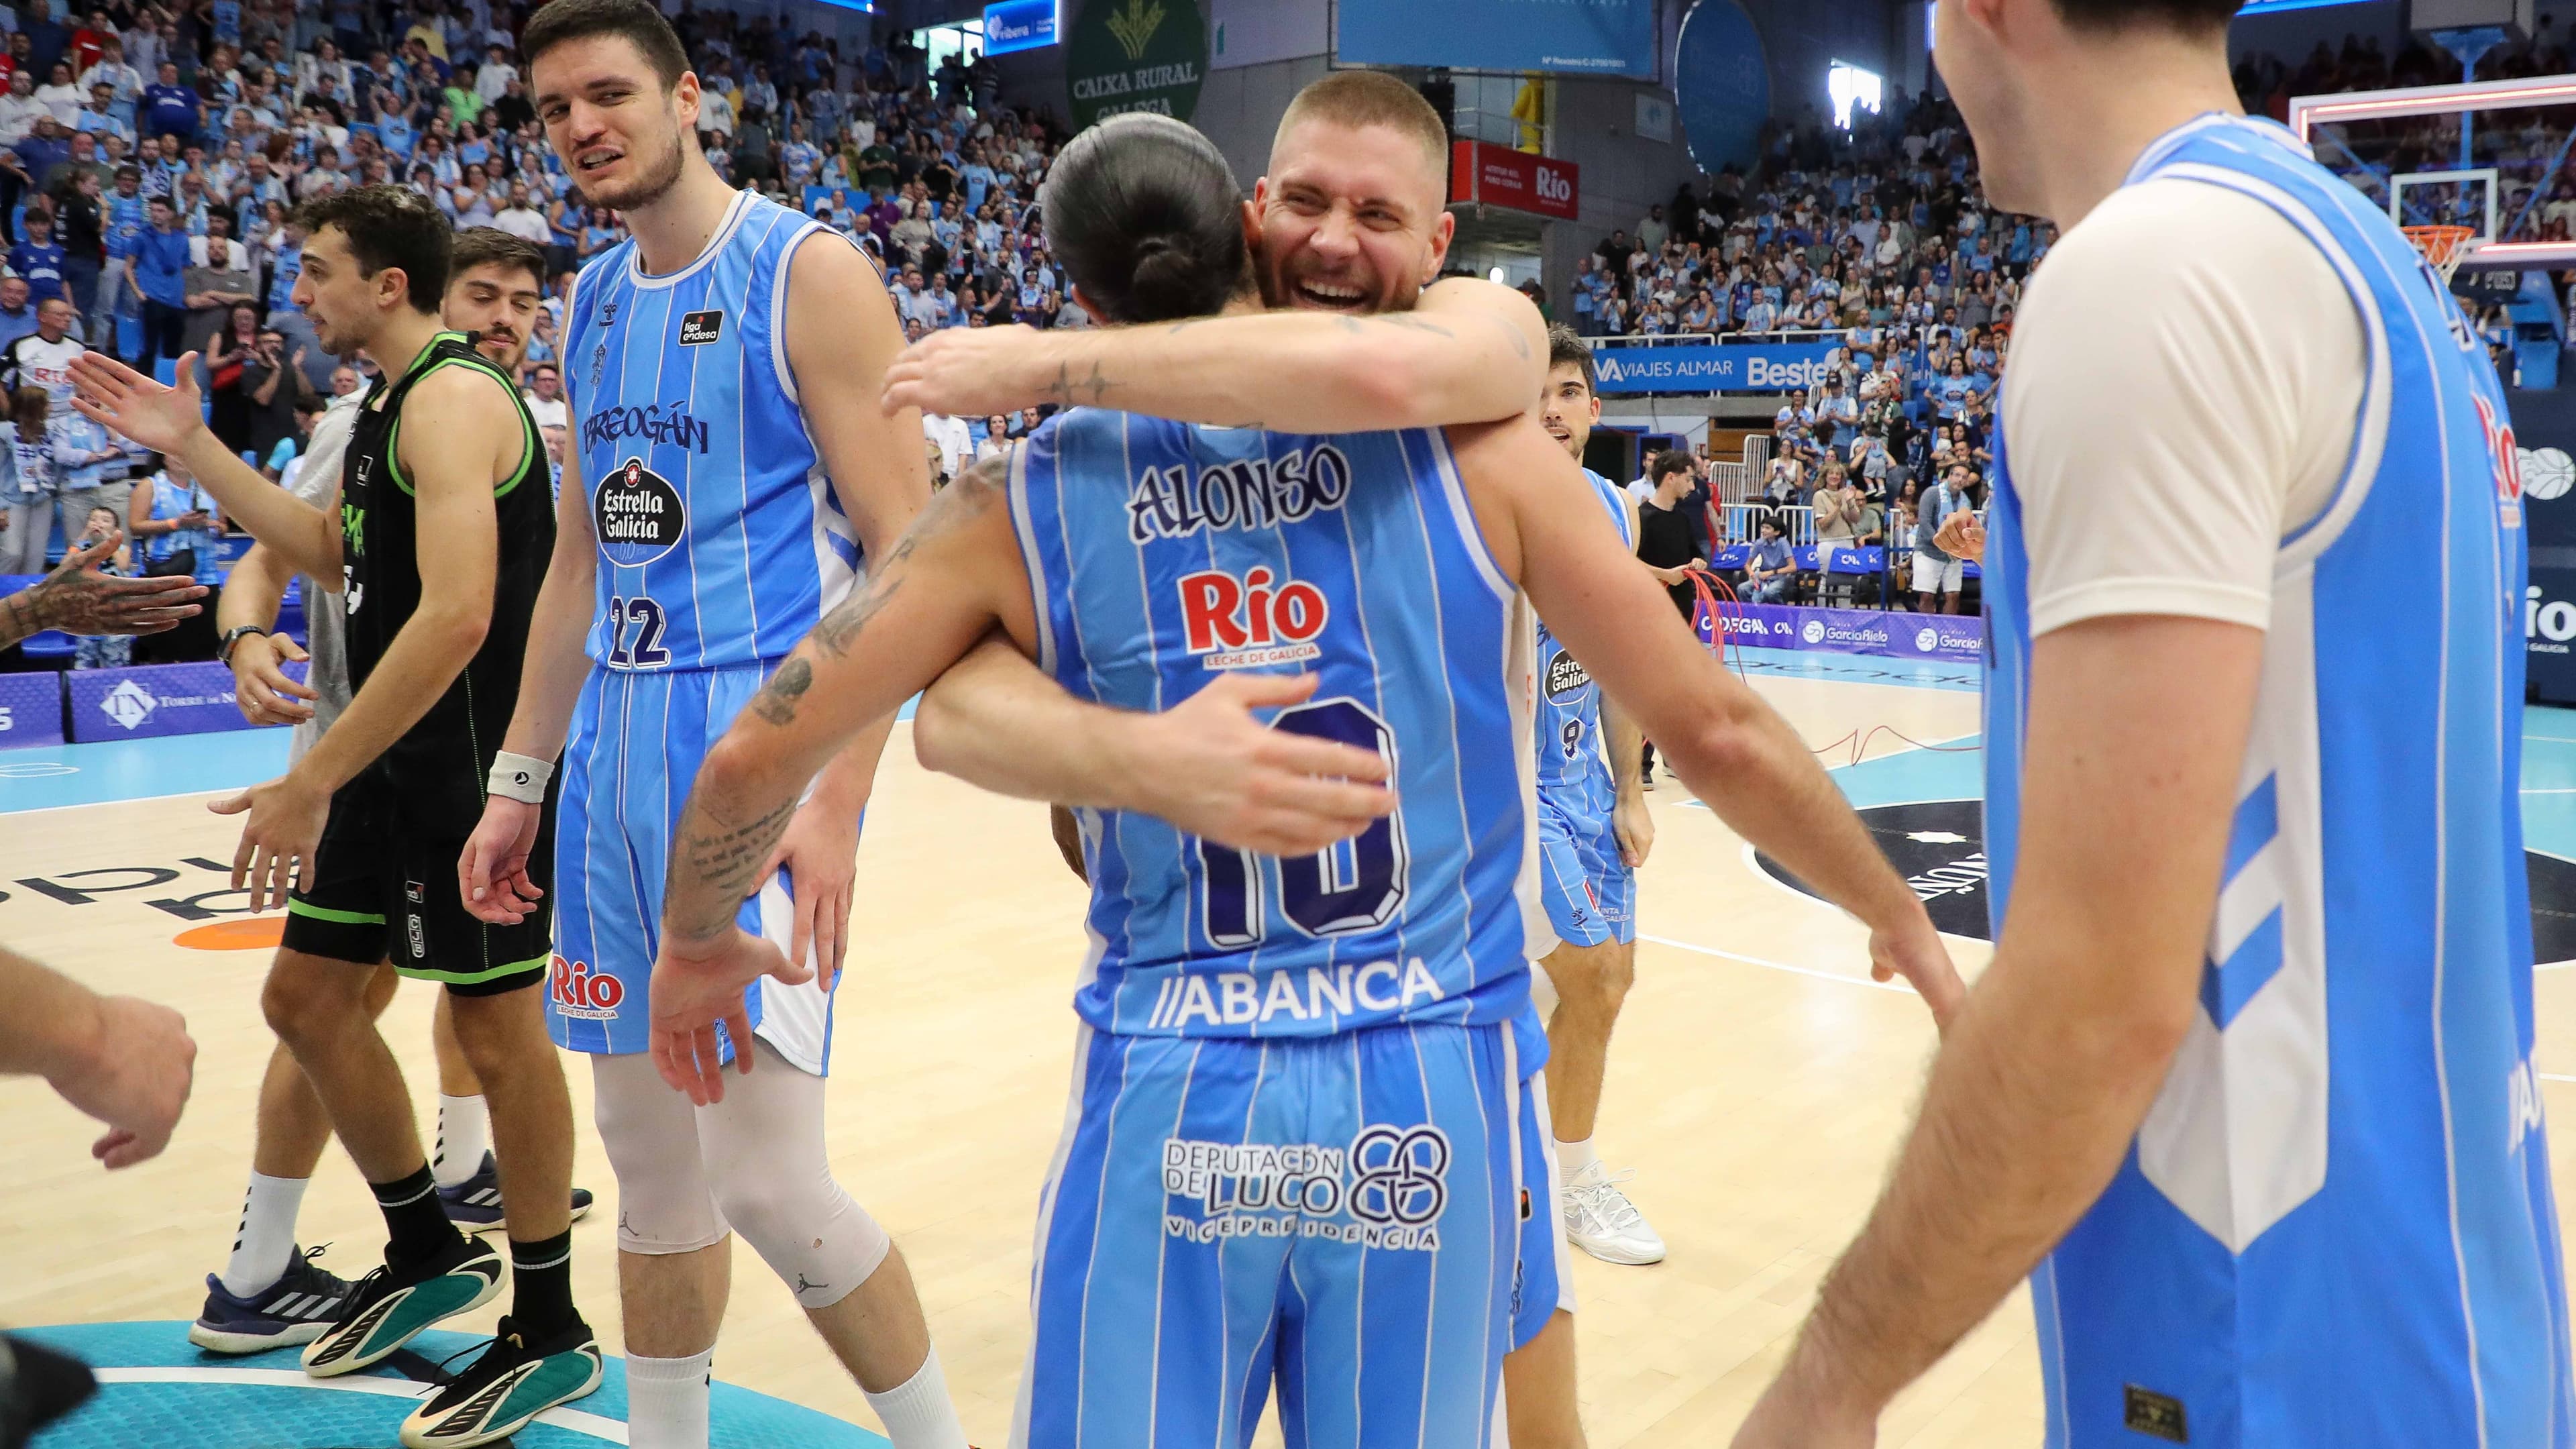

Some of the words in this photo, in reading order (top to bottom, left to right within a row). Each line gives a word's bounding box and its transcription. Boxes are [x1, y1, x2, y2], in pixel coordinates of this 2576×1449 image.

[1073, 71, 1132, 99] CAIXA
[1135, 60, 1198, 91] RURAL
[683, 330, 716, 341] endesa
[685, 321, 700, 333] liga
[1621, 362, 1672, 377] VIAJES
[1676, 360, 1733, 376] ALMAR
[1747, 357, 1828, 387] Beste
[584, 401, 708, 455] BREOGÁN
[603, 488, 663, 514] Estrella
[1124, 443, 1352, 545] ALONSO
[606, 513, 659, 539] Galicia
[608, 596, 672, 670] 22
[1207, 655, 1244, 666] LECHE
[1249, 653, 1265, 663] DE
[1269, 647, 1316, 660] GALICIA
[557, 1006, 575, 1016] LECHE
[1166, 1169, 1203, 1194] DE
